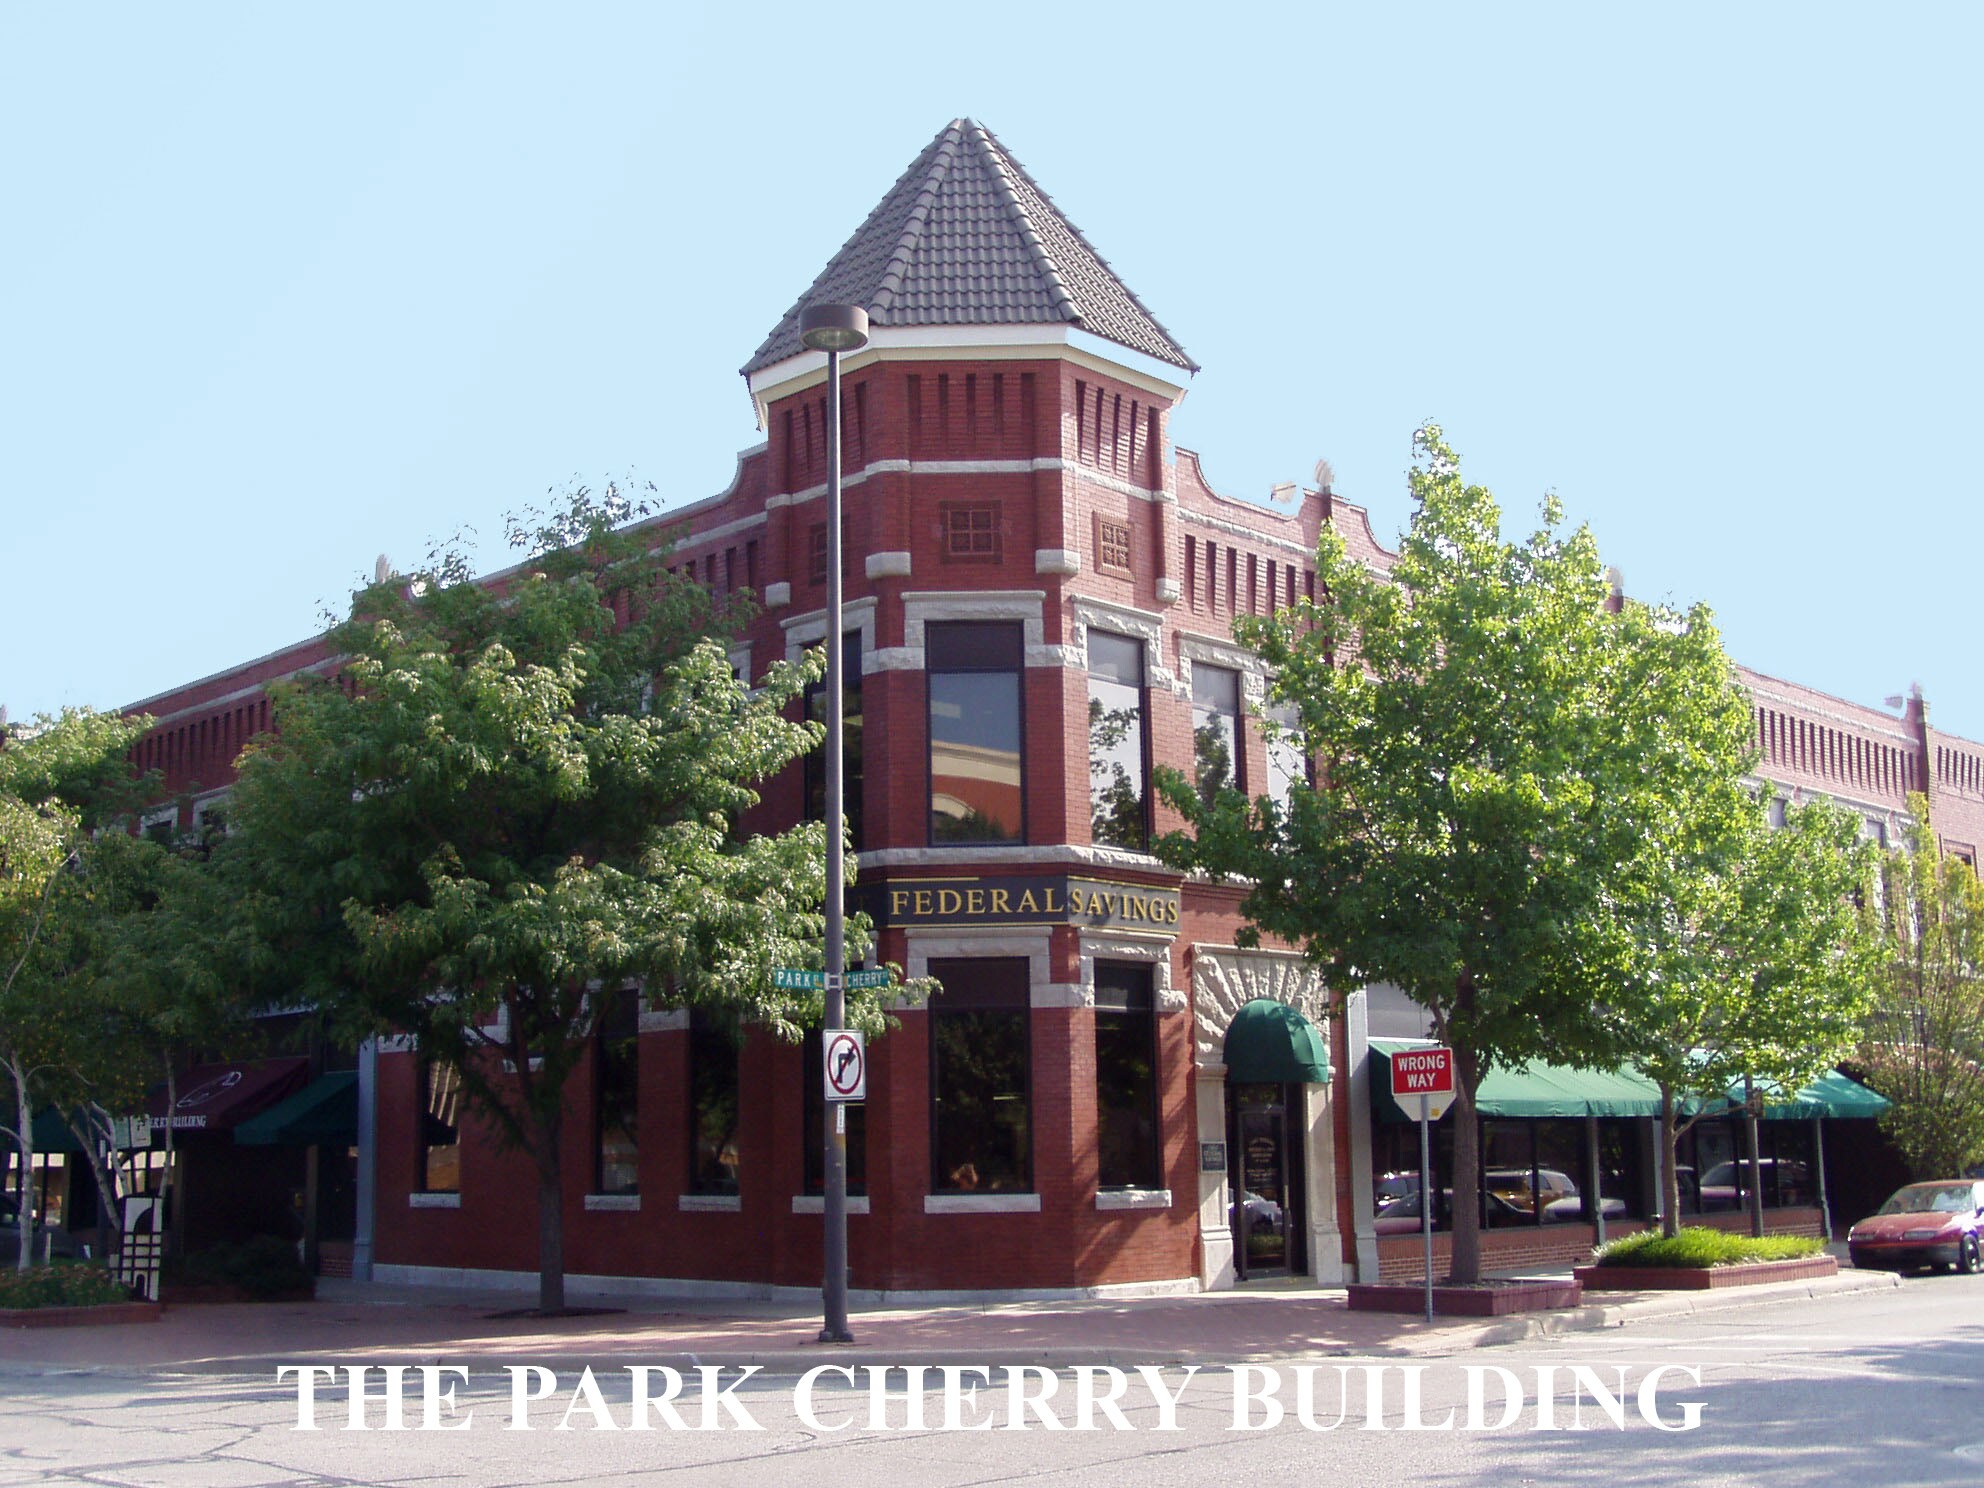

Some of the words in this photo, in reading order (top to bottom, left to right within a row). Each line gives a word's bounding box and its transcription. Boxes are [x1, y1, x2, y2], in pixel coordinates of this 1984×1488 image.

[890, 887, 1065, 915] FEDERAL
[1069, 887, 1179, 924] SAVINGS
[777, 971, 811, 987] PARK
[846, 972, 881, 988] CHERRY
[1398, 1054, 1446, 1072] WRONG
[1407, 1072, 1436, 1089] WAY
